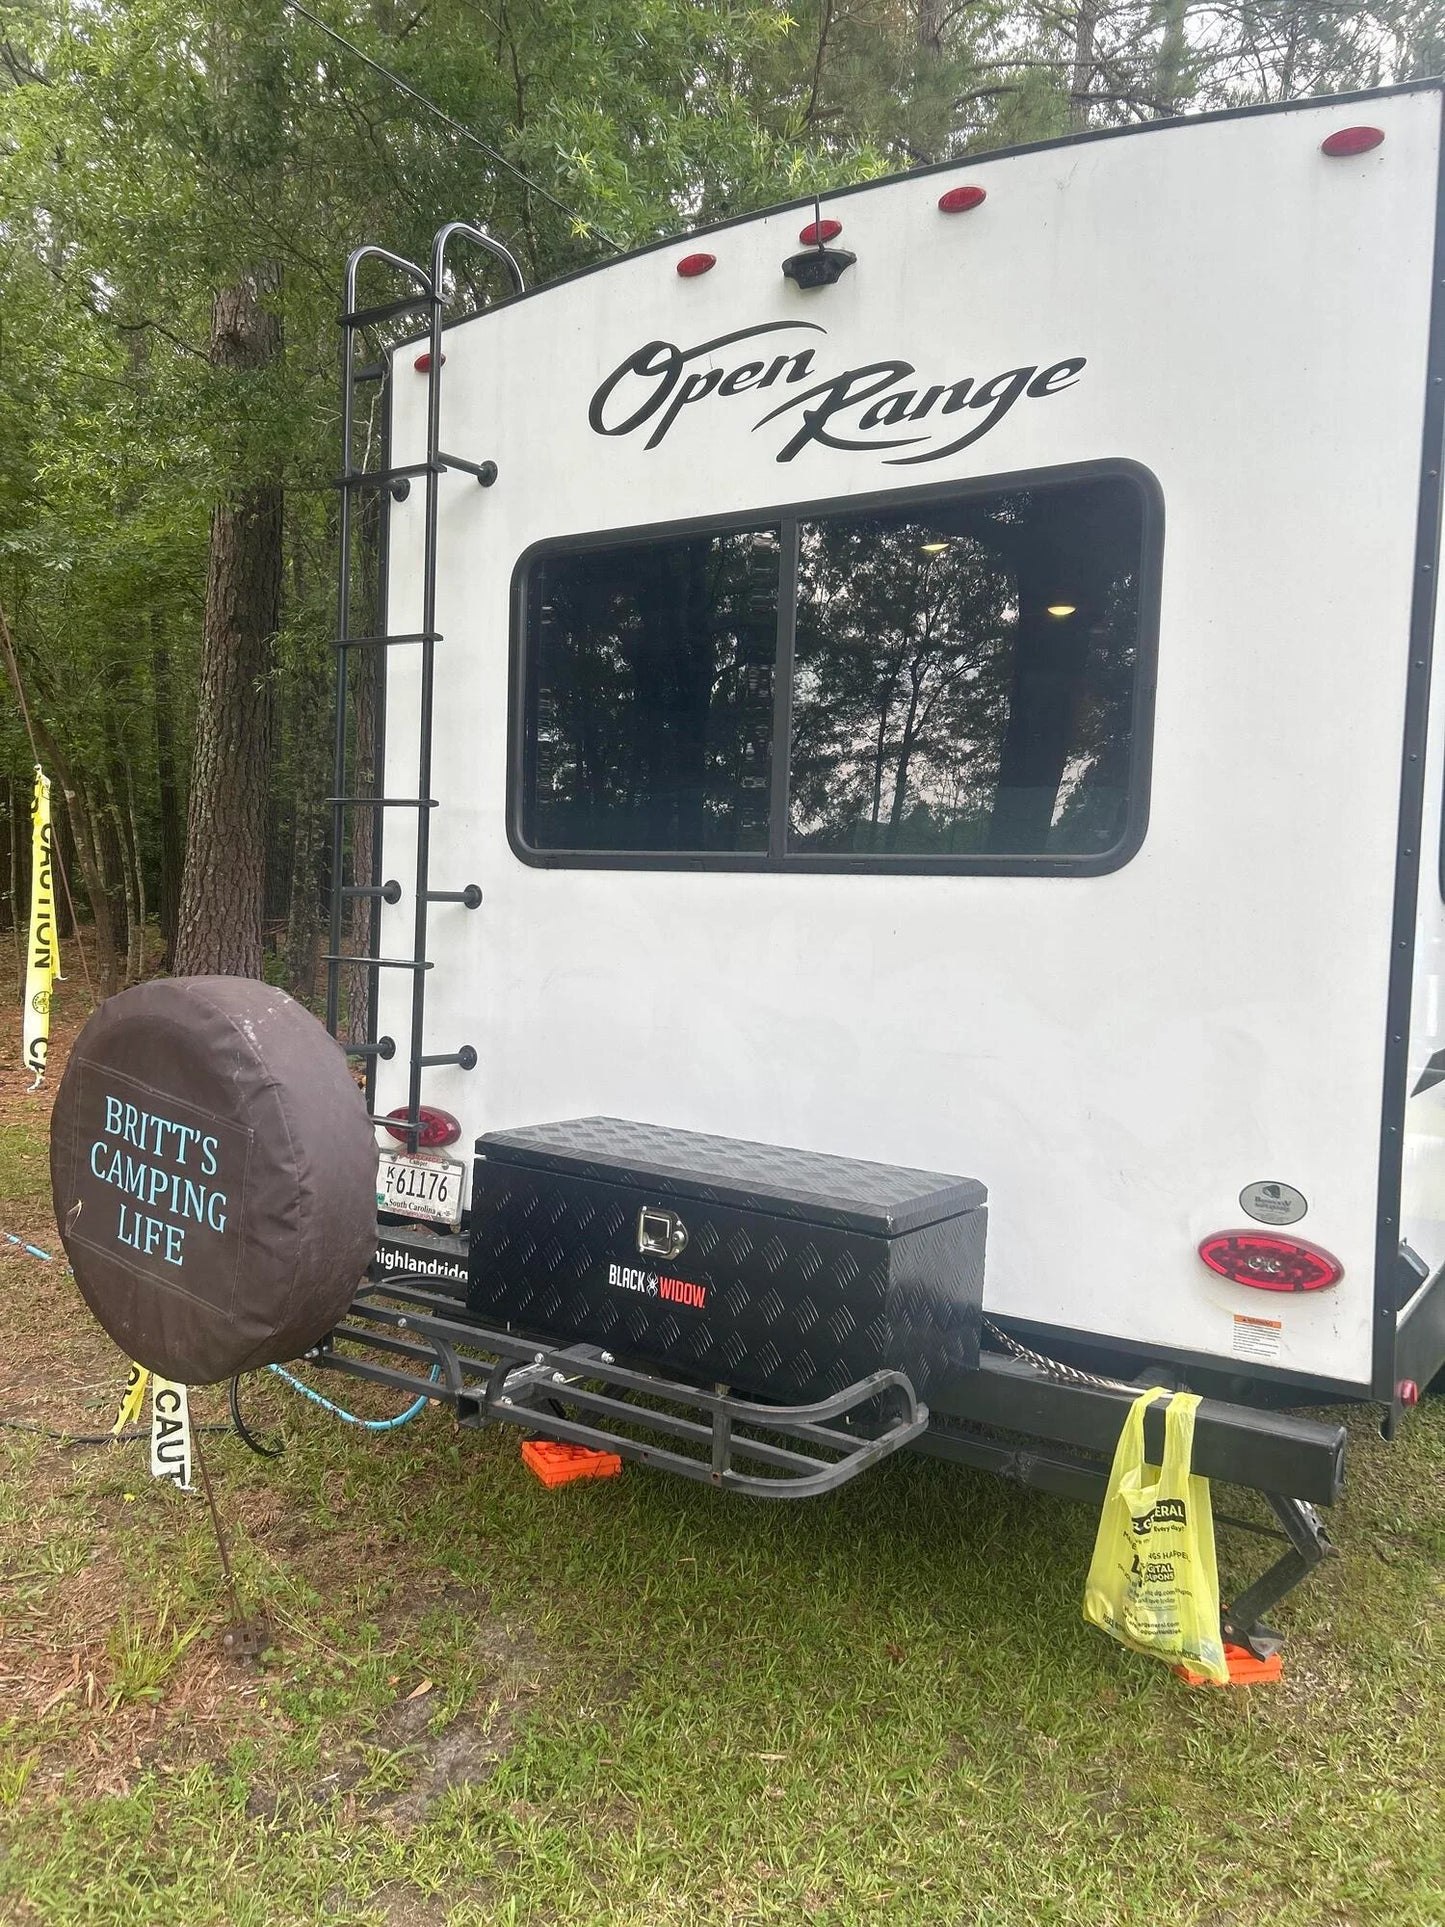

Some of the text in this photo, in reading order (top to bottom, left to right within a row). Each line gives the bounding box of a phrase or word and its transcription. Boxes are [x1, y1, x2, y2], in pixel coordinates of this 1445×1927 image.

[588, 320, 1087, 465] Open Range
[105, 1095, 218, 1175] BRITT'S
[90, 1141, 227, 1233] CAMPING
[389, 1198, 407, 1209] South
[408, 1202, 436, 1215] Carolina
[396, 1168, 448, 1202] 61176
[117, 1203, 185, 1266] LIFE
[608, 1263, 706, 1308] BLACK WIDOW
